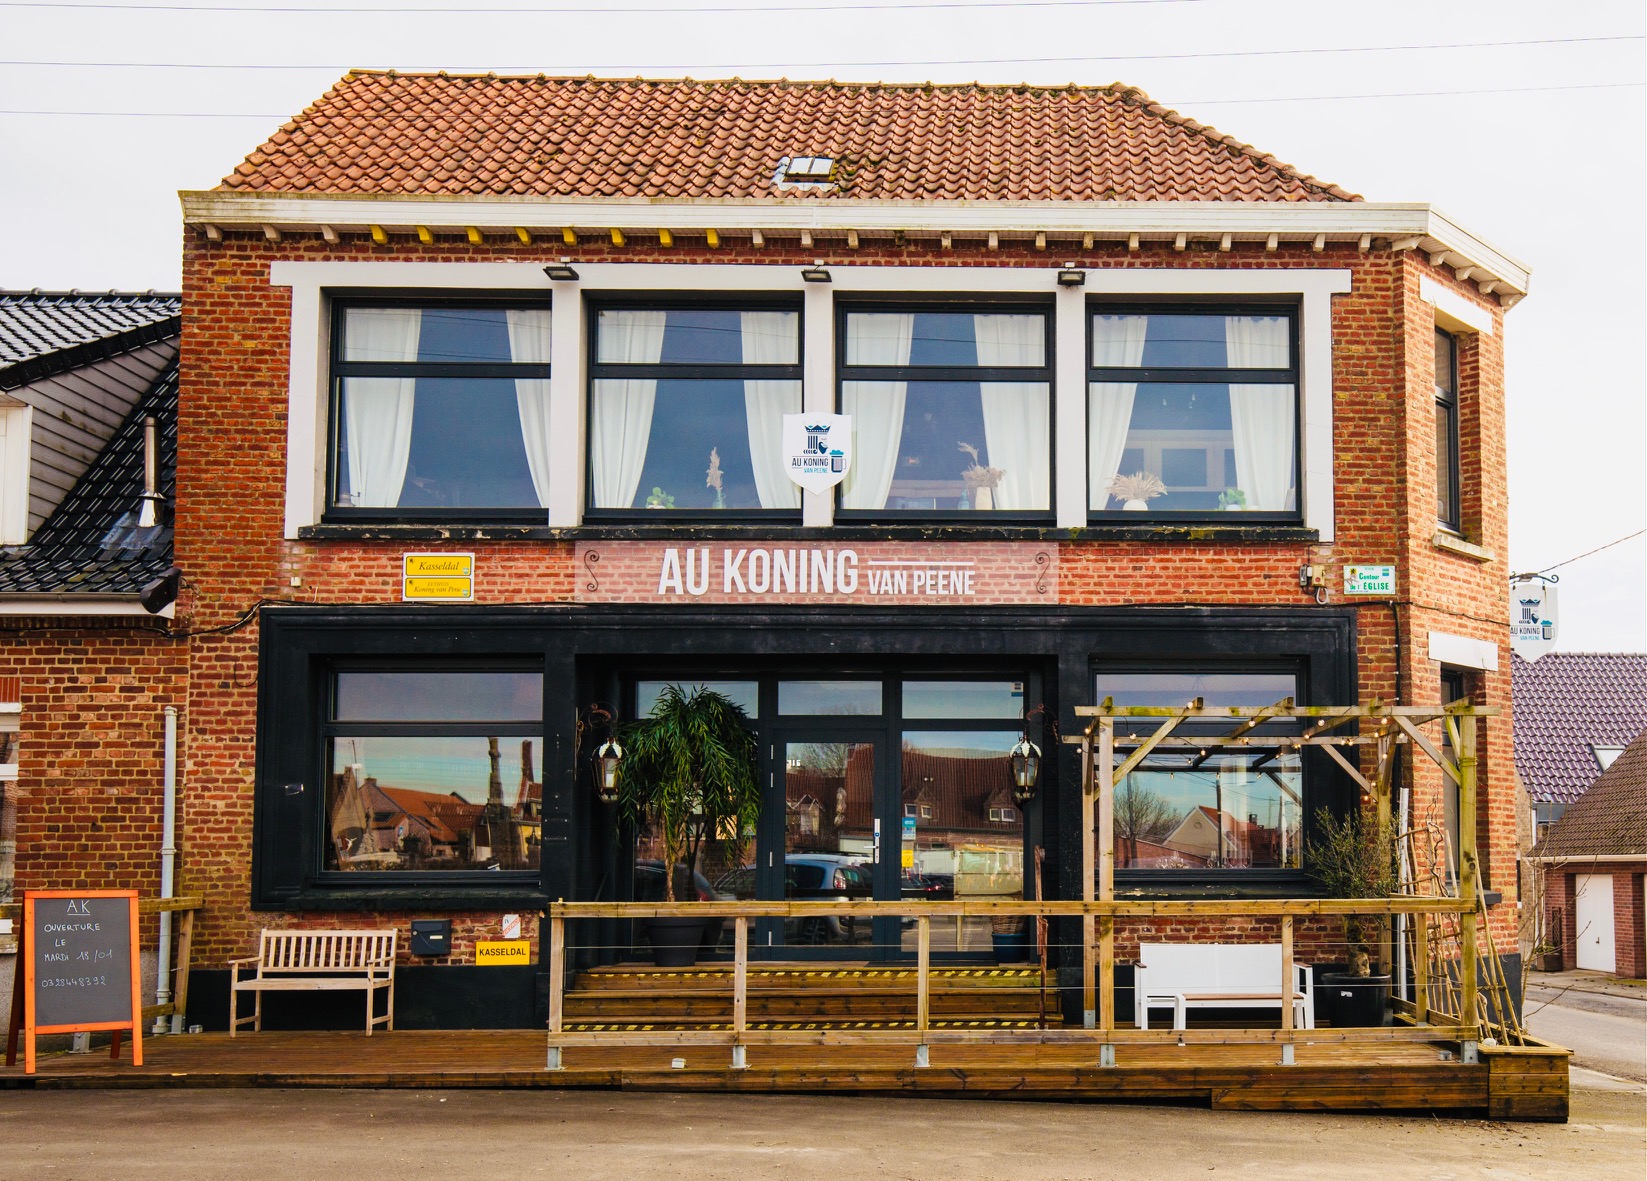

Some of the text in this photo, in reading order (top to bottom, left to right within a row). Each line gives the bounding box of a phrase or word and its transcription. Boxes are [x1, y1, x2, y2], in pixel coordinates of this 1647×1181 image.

[792, 458, 828, 466] AU KONING
[419, 562, 460, 570] Kasseldal
[658, 548, 859, 595] AU KONING
[867, 570, 975, 595] VAN PEENE
[44, 923, 100, 932] OUVERTURE
[55, 939, 66, 947] LE
[479, 948, 526, 956] KASSELDAL
